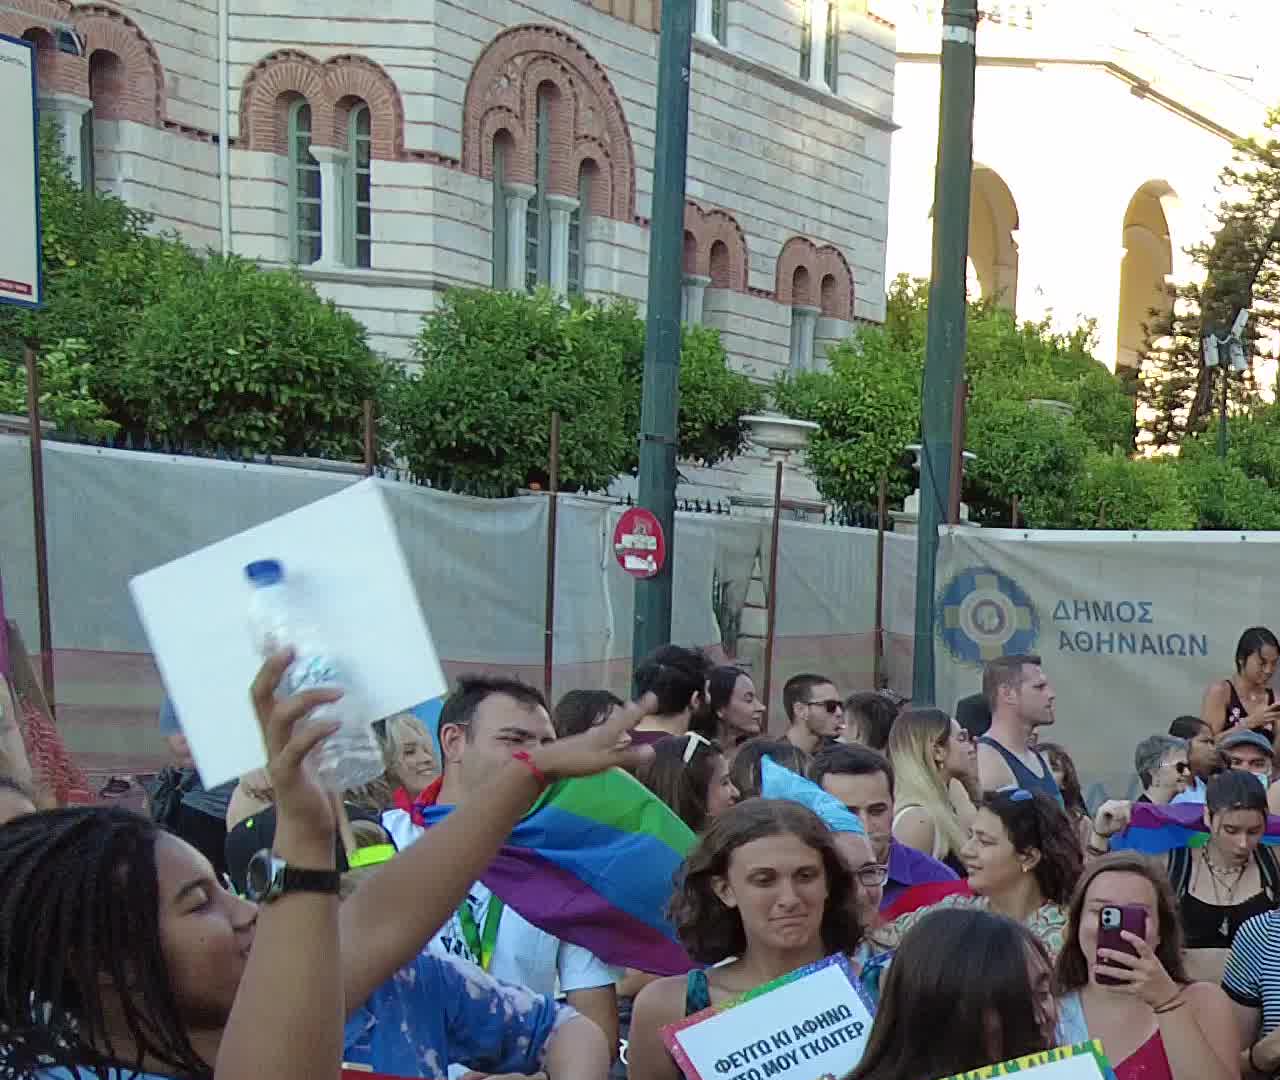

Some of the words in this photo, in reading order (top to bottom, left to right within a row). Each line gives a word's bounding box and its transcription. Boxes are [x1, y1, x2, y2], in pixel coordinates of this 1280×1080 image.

[1052, 600, 1154, 624] ΔΗΜΟΣ
[1058, 631, 1208, 657] ΑΘΗΝΑΙΩΝ
[713, 1038, 772, 1074] ΦΕΥΓΩ
[769, 1032, 794, 1050] ΚΙ
[794, 1004, 853, 1041] ΑΦΗΝΩ
[763, 1048, 800, 1078] ΜΟΥ
[801, 1021, 866, 1060] ΓΚΛΙΤΕΡ
